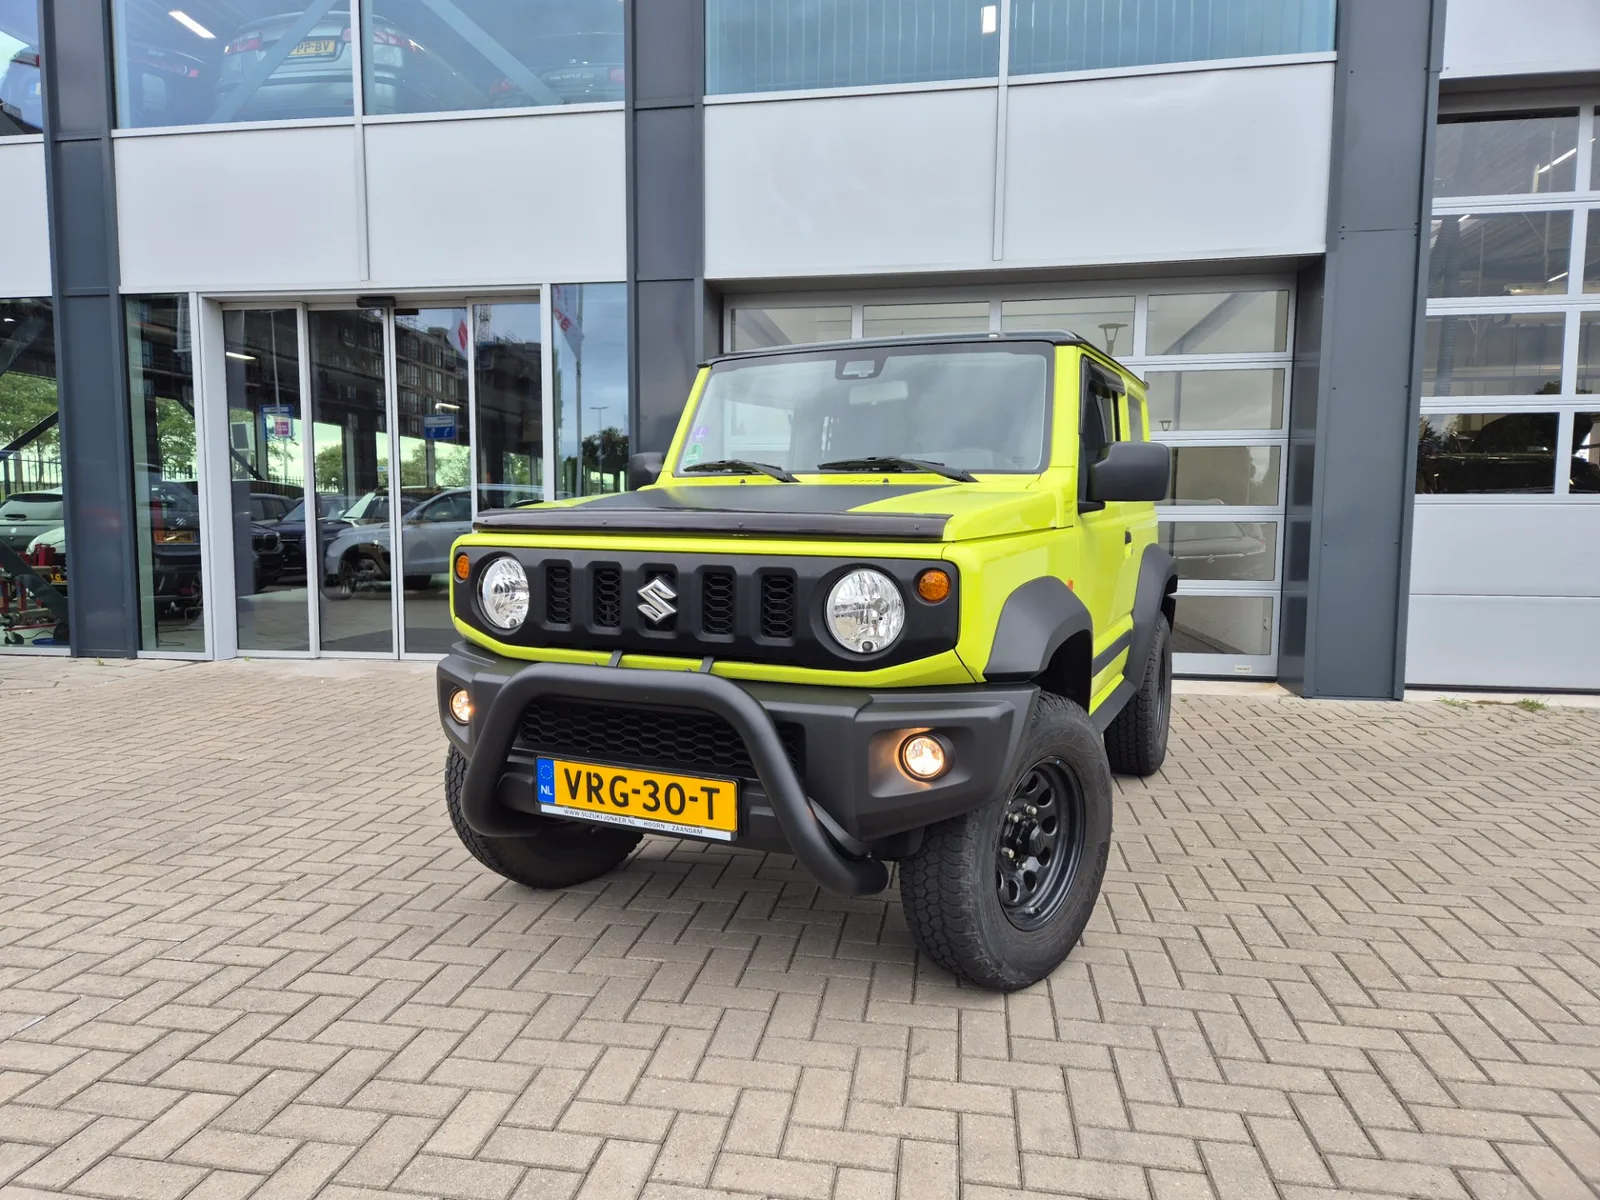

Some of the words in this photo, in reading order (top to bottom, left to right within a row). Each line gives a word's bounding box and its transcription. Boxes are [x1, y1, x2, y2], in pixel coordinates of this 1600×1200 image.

[540, 784, 553, 796] NL
[563, 768, 720, 820] VRG-30-T
[643, 821, 665, 829] HOORN
[671, 825, 704, 835] ZAANDAM
